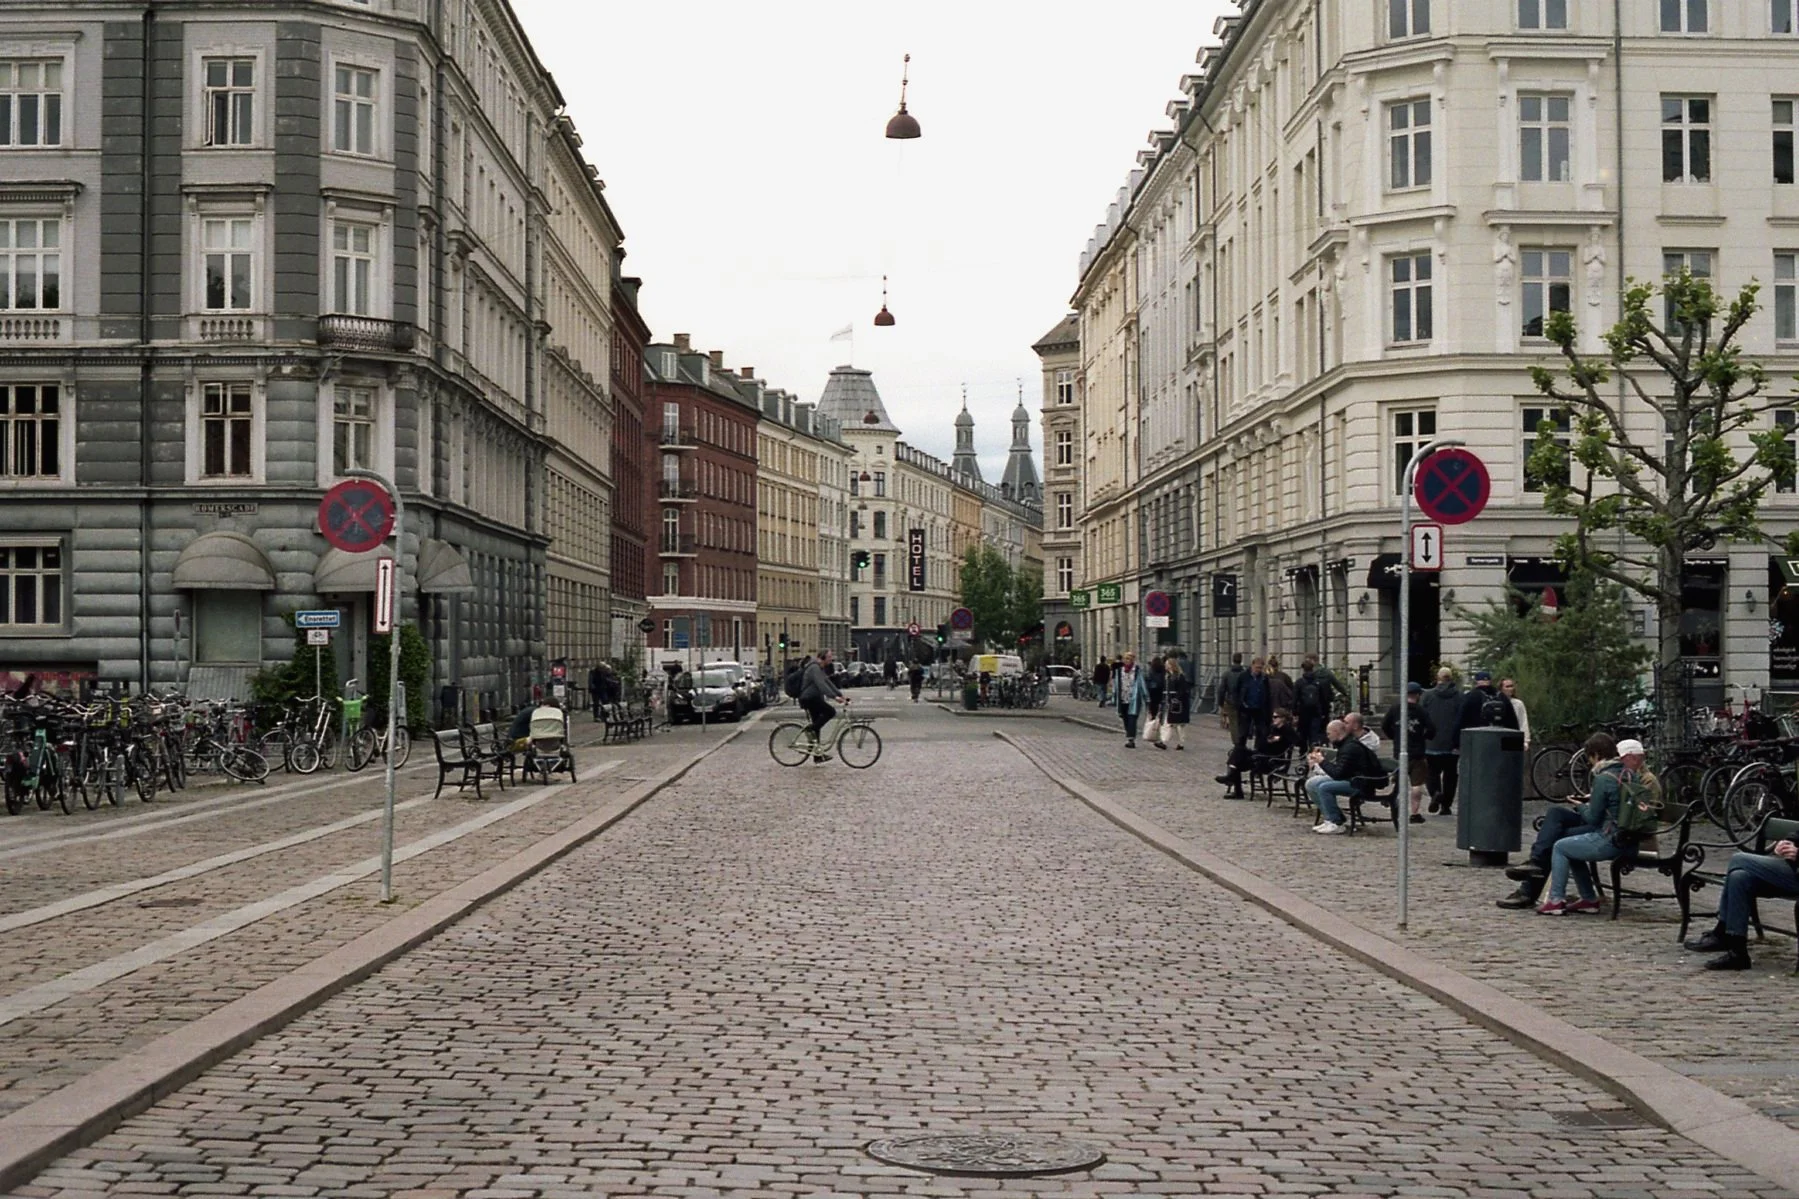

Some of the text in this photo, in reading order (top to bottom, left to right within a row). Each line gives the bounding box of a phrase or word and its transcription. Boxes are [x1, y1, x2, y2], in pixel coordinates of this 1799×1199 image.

[911, 534, 923, 587] HOTEL
[1100, 588, 1116, 597] 365
[1072, 595, 1086, 603] 365
